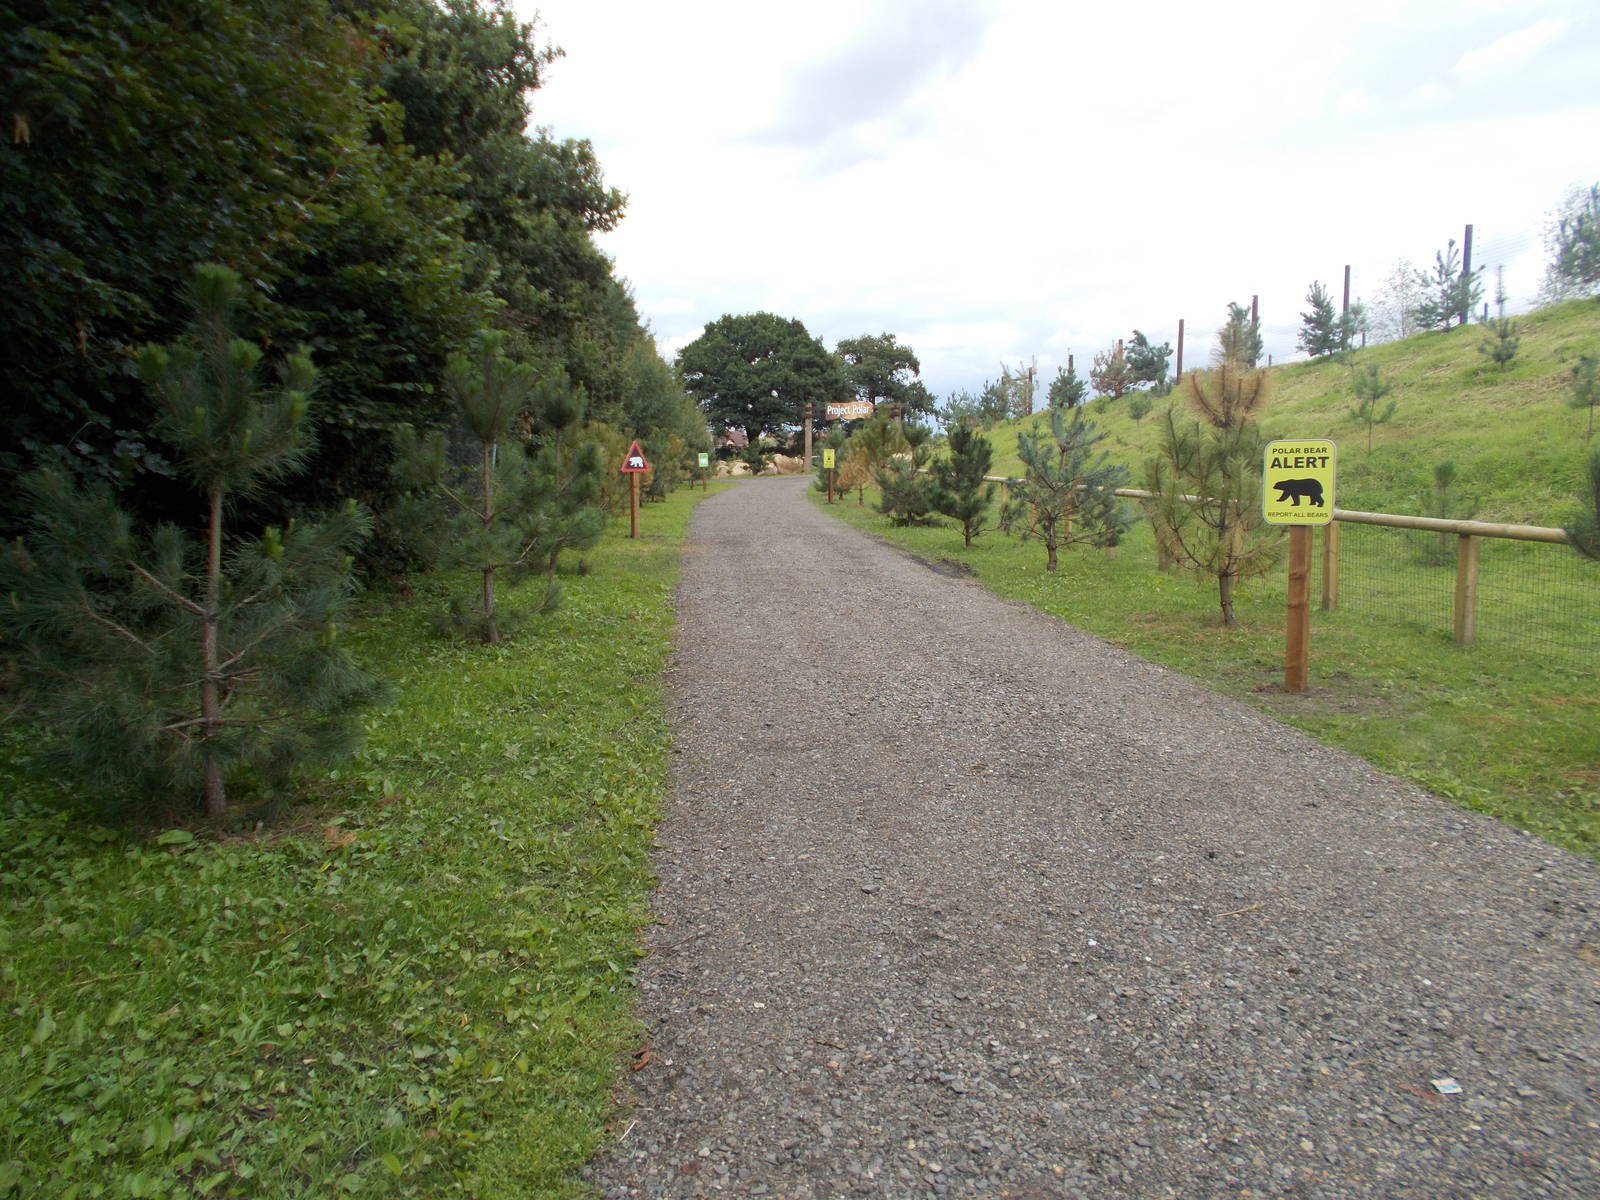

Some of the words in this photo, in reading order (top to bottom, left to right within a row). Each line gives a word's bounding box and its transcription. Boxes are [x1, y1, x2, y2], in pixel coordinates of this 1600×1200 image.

[827, 405, 850, 417] Project
[852, 404, 870, 414] Polar
[1270, 456, 1330, 468] ALERT
